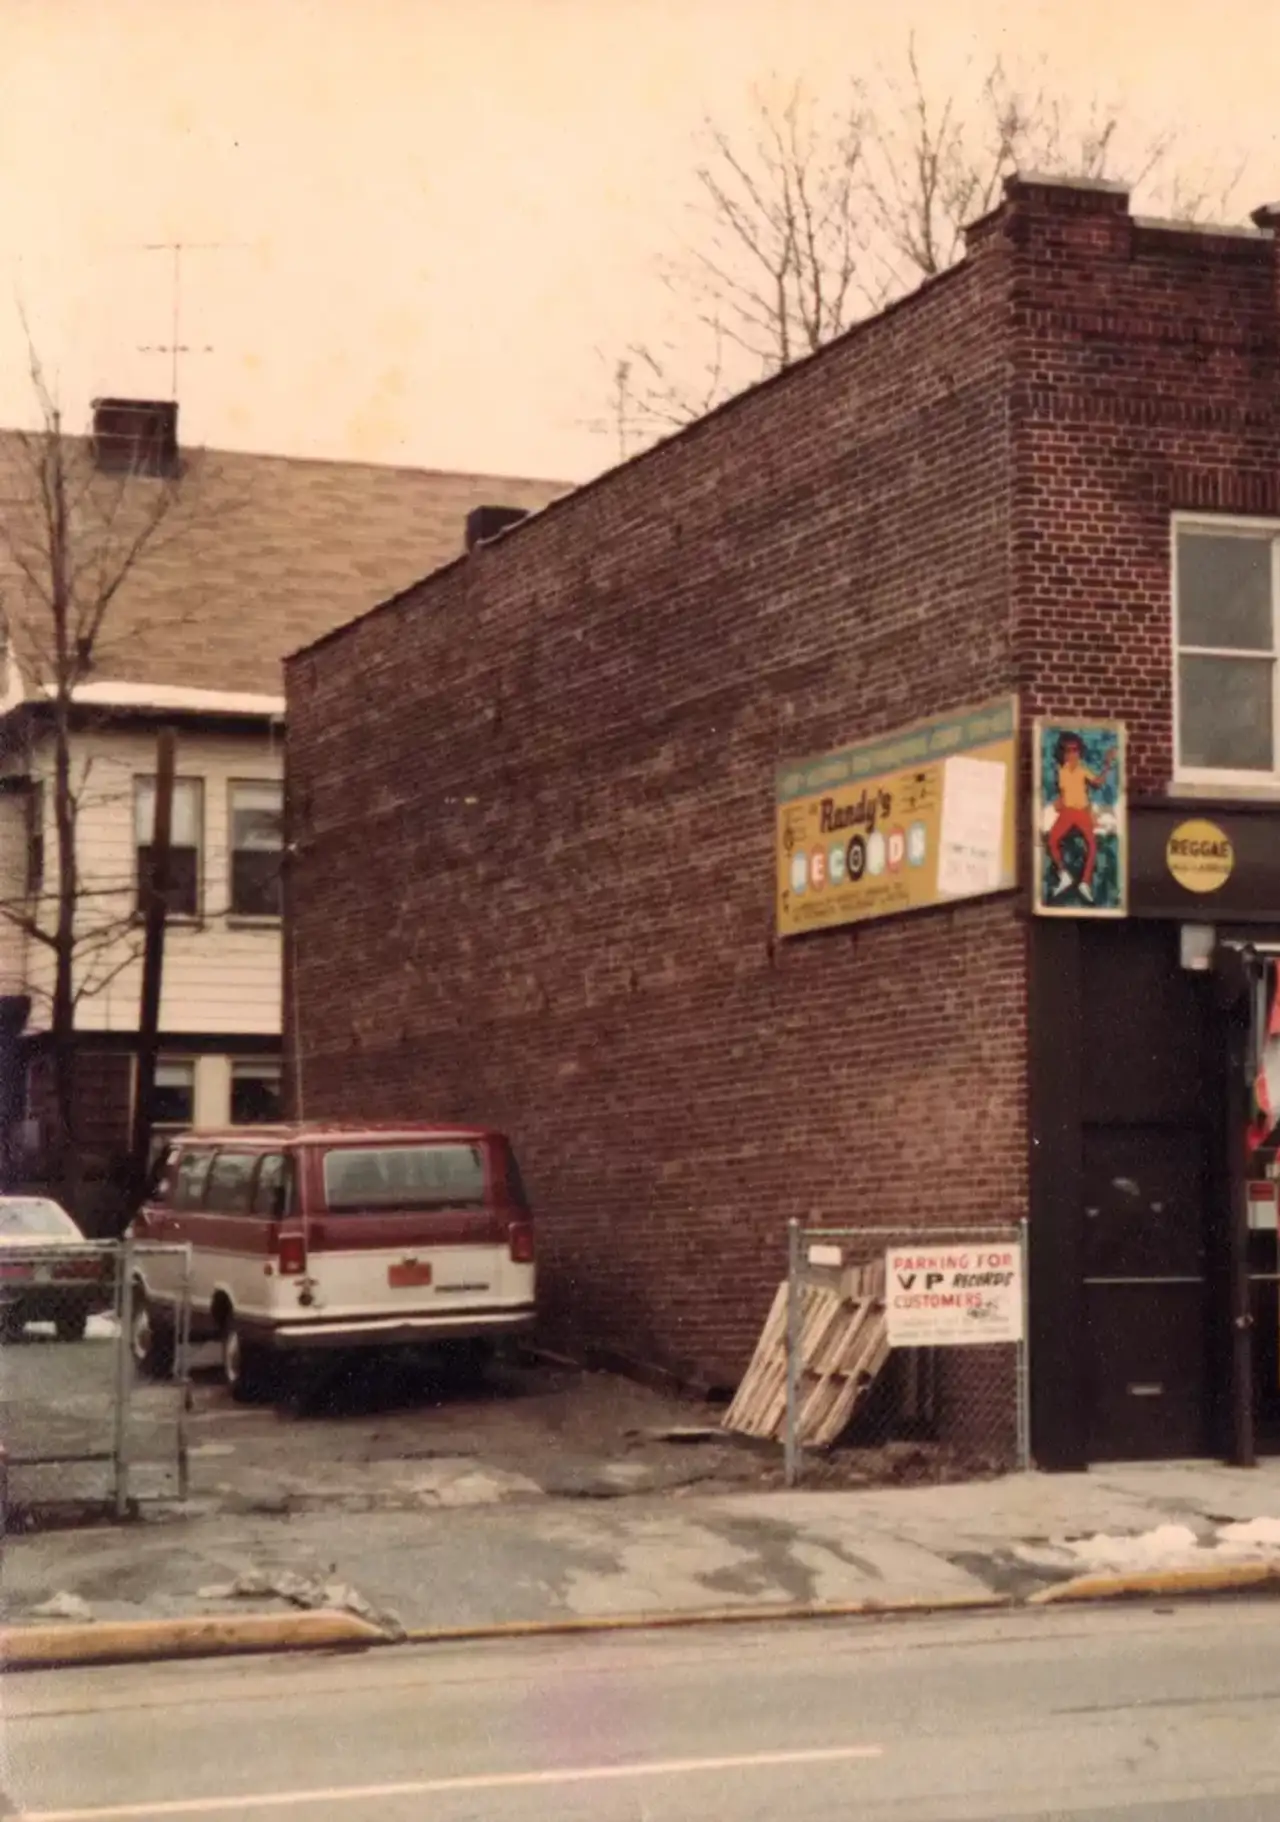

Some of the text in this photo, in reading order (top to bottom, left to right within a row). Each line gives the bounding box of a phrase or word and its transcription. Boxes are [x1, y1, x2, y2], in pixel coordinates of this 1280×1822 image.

[820, 788, 893, 834] Randy's
[1170, 839, 1229, 857] REGGAE
[893, 1253, 1013, 1270] PARKING FOR
[952, 1271, 1014, 1289] RECORDS
[893, 1292, 983, 1309] CUSTOMERS
